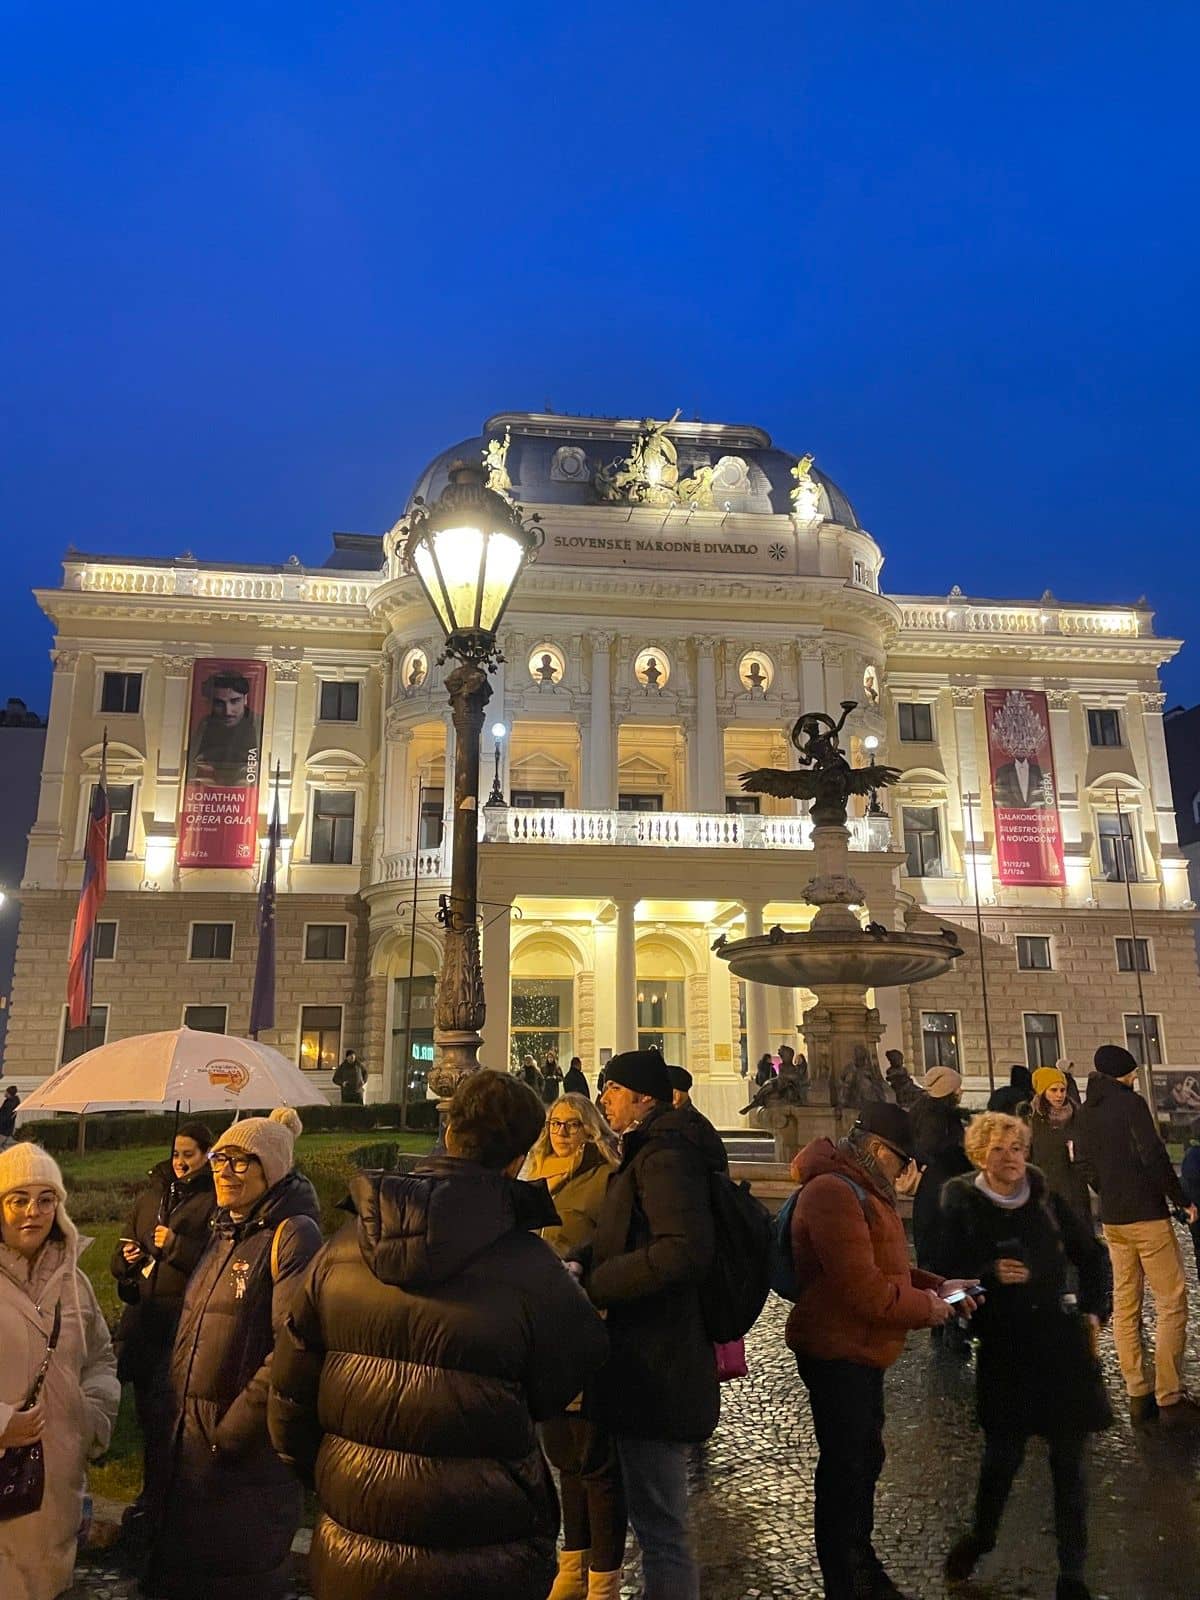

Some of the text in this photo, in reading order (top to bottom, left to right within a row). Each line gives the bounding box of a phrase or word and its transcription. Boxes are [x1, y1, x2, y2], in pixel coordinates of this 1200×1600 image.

[704, 543, 758, 554] DIVADLO
[246, 747, 257, 783] OPERA
[1044, 773, 1054, 805] OPERA
[187, 792, 245, 802] JONATHAN
[187, 803, 240, 813] TETELMAN
[186, 814, 252, 825] OPERA GALA
